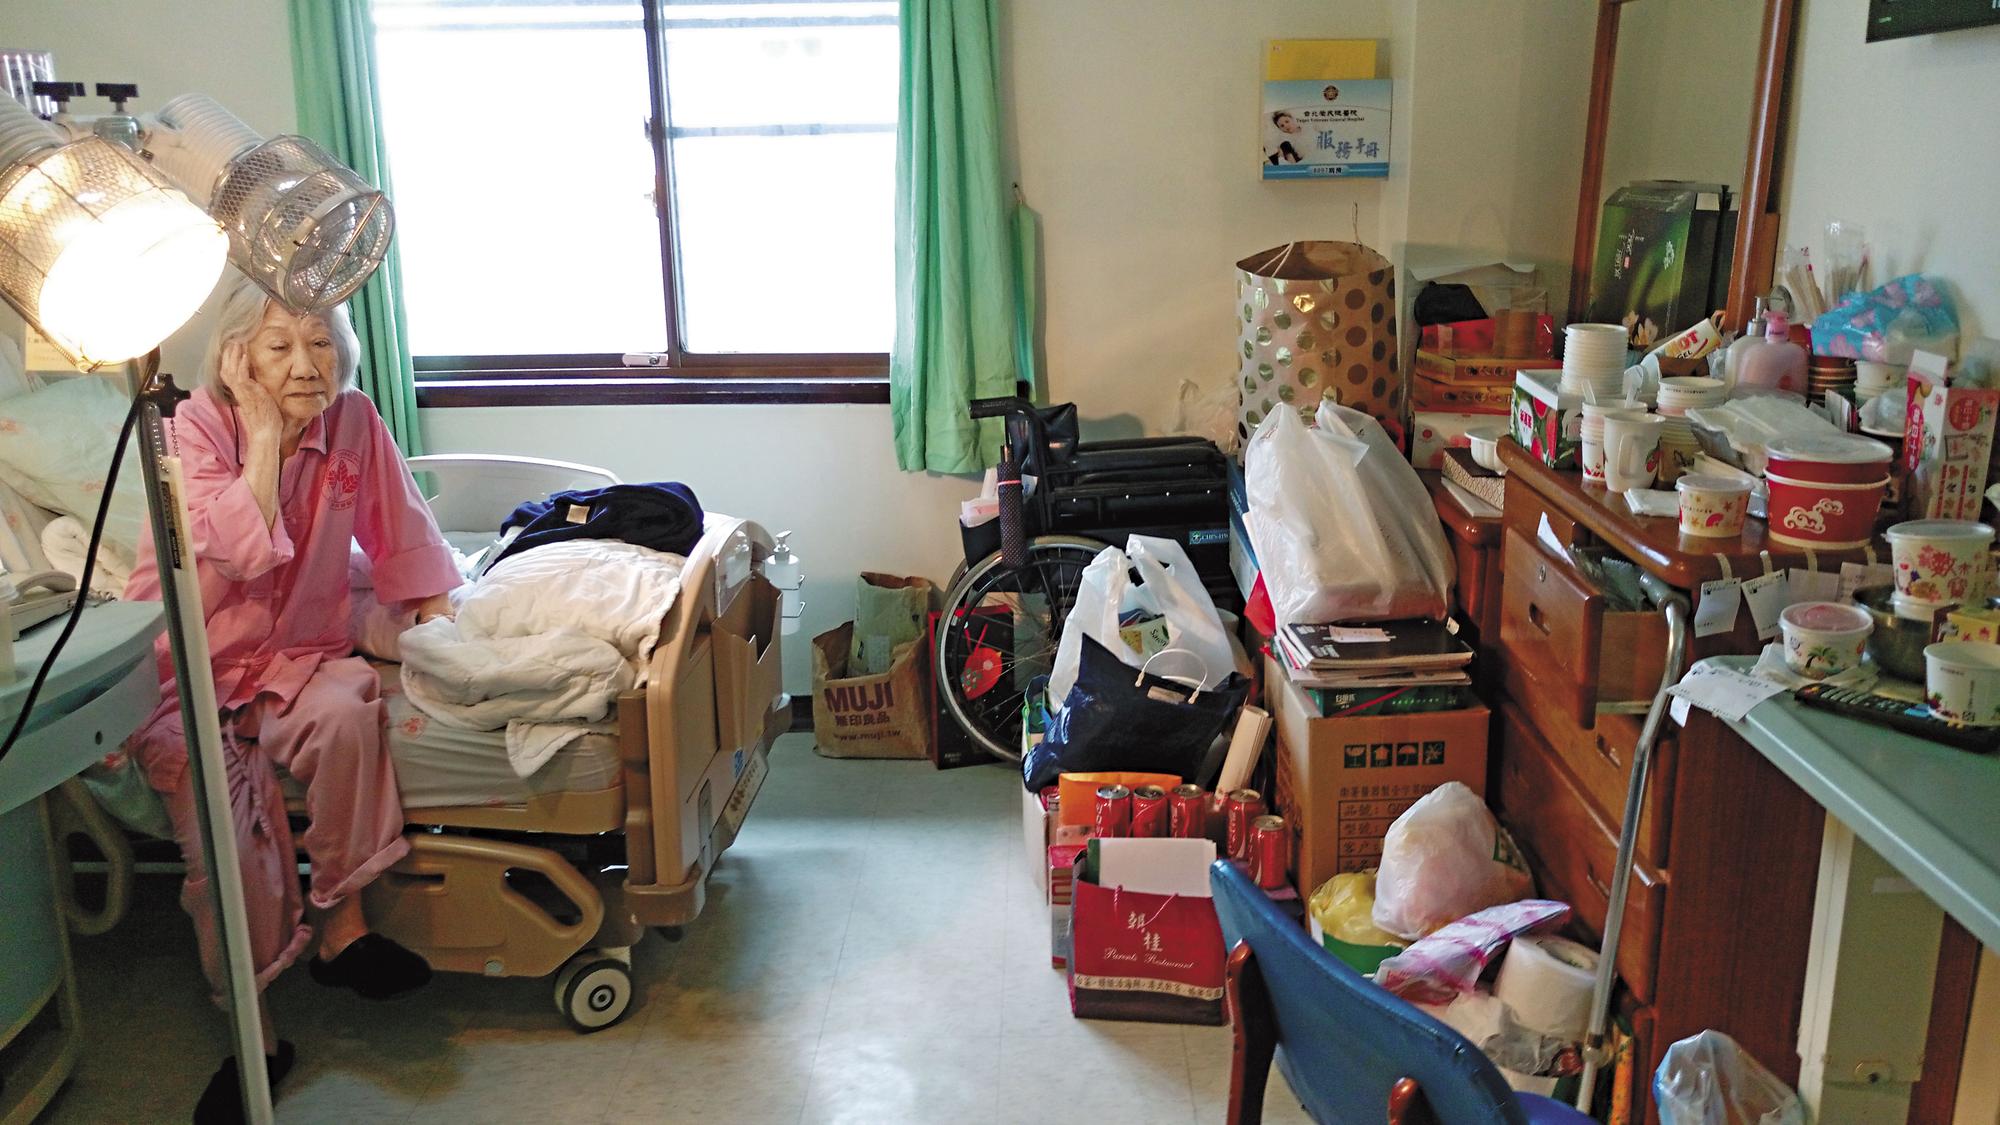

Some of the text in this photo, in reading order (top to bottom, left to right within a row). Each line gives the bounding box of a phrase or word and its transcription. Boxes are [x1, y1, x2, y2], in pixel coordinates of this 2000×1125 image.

[1316, 130, 1379, 159] 服務手冊
[824, 681, 894, 712] MUJI
[835, 711, 890, 727] 無印良品
[1103, 946, 1195, 969] Parents Restaurant
